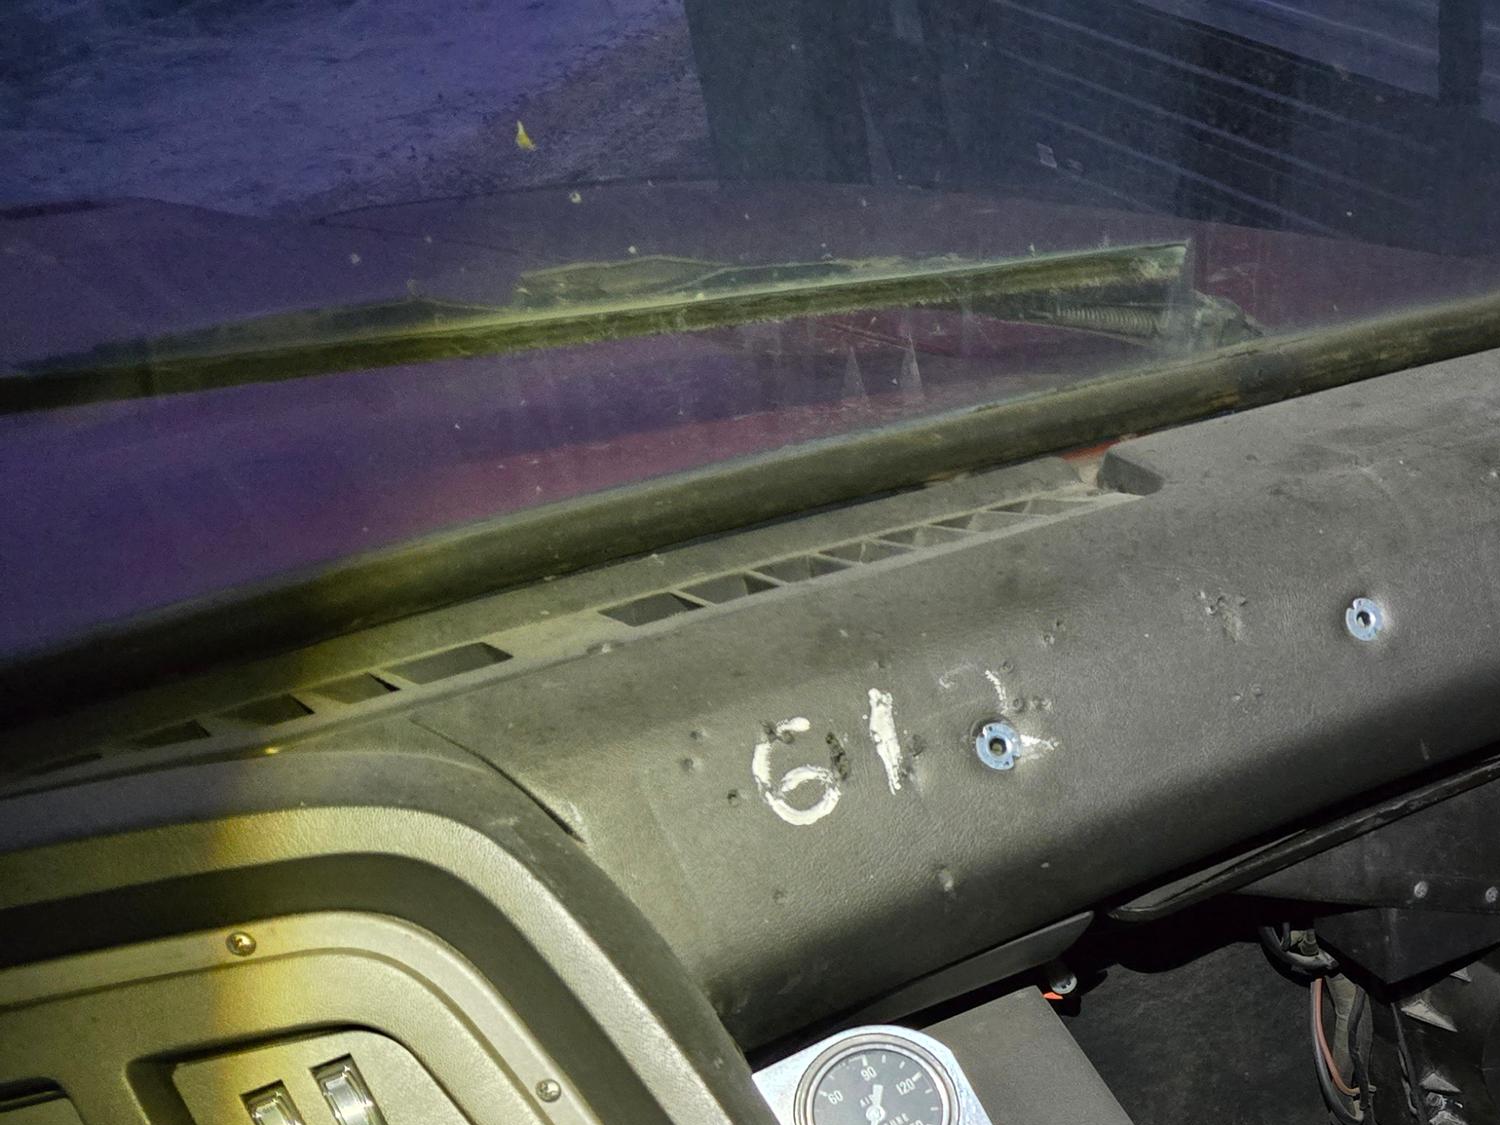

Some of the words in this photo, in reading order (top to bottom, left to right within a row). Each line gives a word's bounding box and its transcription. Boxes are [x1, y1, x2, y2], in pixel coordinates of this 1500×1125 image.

[860, 1066, 878, 1082] 90
[896, 1078, 916, 1096] 120
[827, 1090, 844, 1105] 60
